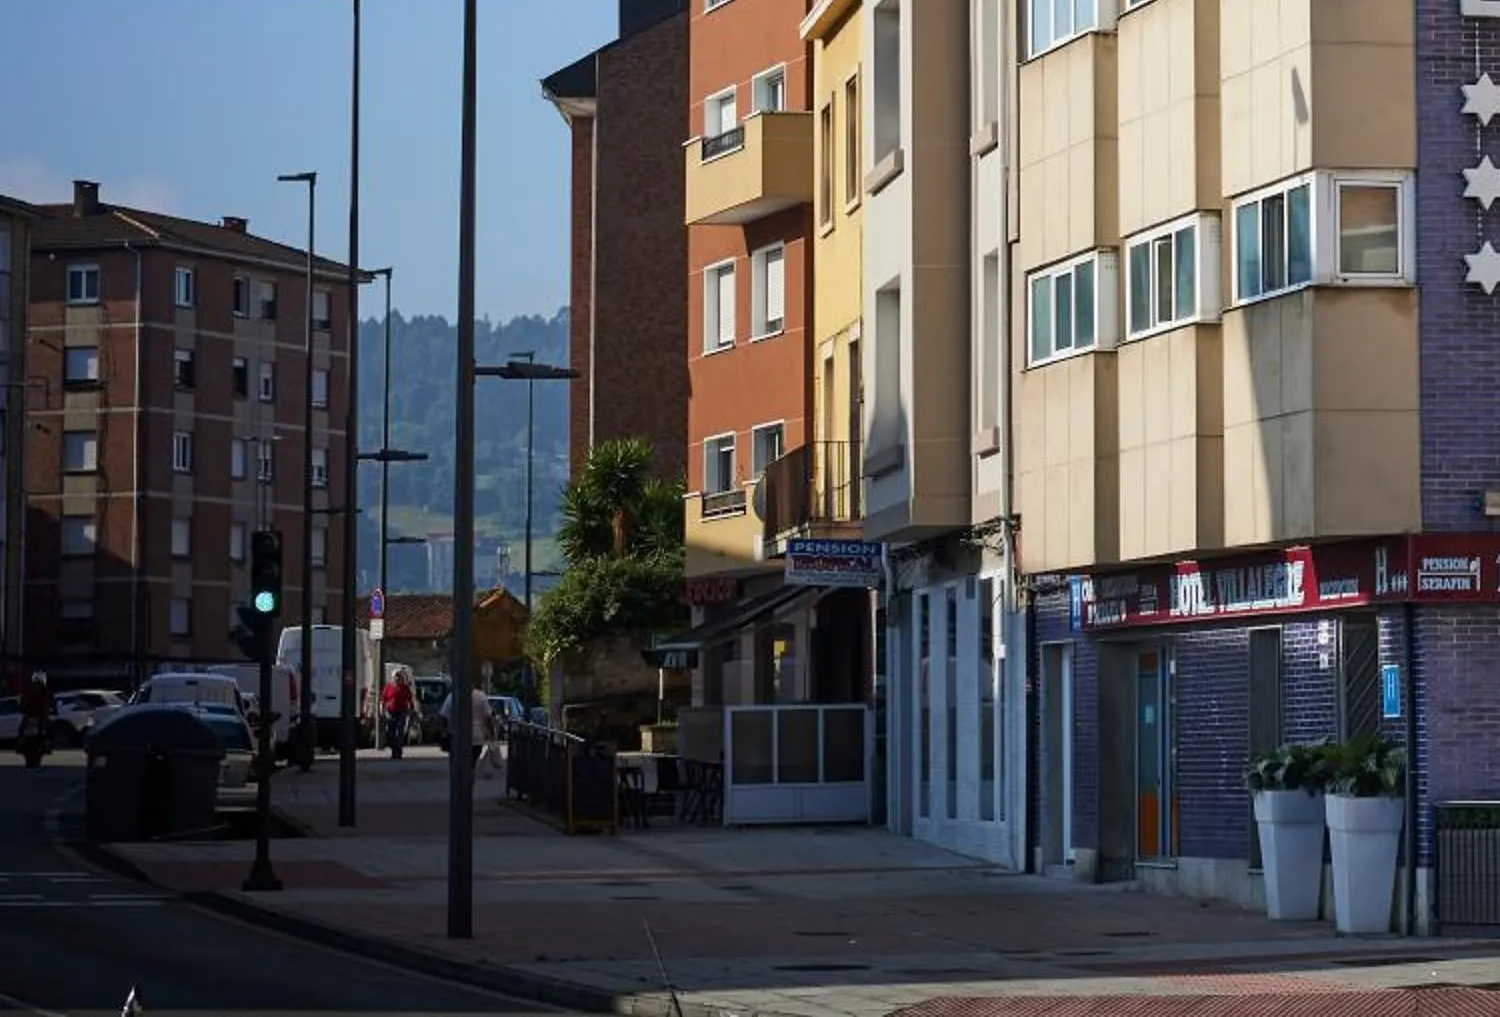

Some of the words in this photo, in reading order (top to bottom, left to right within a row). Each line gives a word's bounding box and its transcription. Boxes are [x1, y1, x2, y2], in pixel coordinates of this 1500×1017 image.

[793, 542, 876, 554] PENSION
[1423, 558, 1469, 571] PENSION
[1421, 577, 1471, 591] SERAFIN
